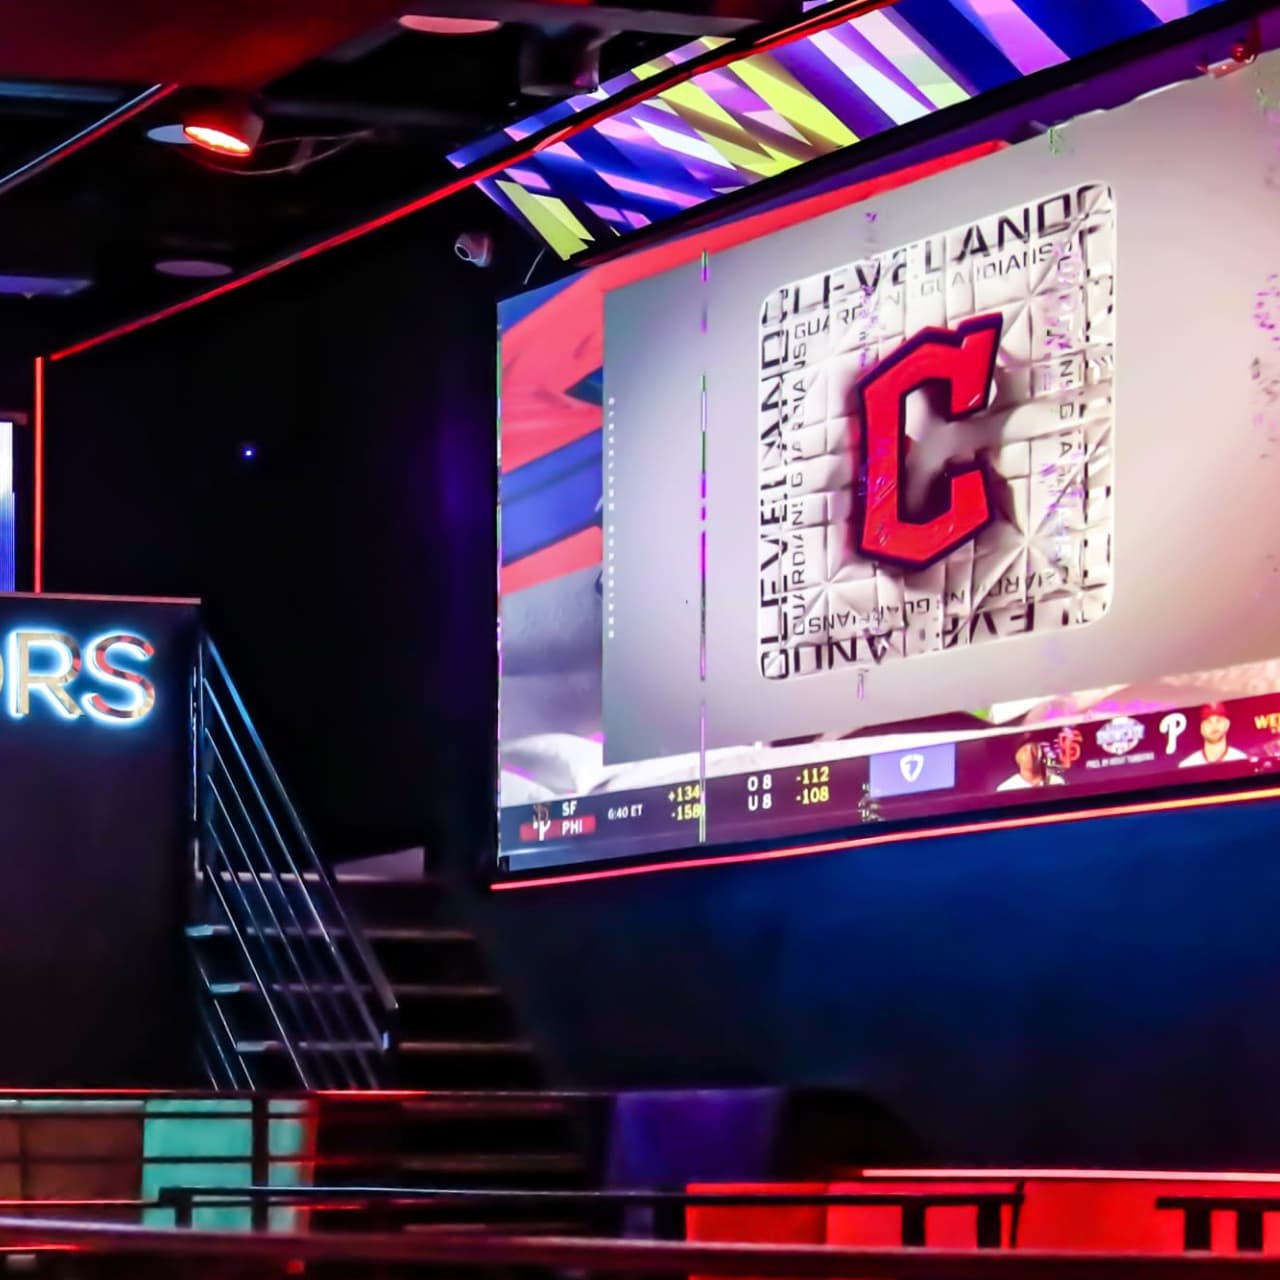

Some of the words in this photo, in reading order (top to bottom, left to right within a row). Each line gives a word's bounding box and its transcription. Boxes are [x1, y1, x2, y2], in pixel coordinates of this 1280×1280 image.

[856, 312, 1003, 571] C
[762, 773, 773, 790] 8
[795, 765, 830, 785] -112
[667, 784, 701, 803] +134
[747, 794, 759, 812] U
[762, 792, 773, 810] 8
[795, 785, 830, 805] -108
[562, 799, 578, 817] SF
[630, 803, 643, 818] ET
[671, 802, 704, 821] -158
[562, 818, 583, 836] PHI
